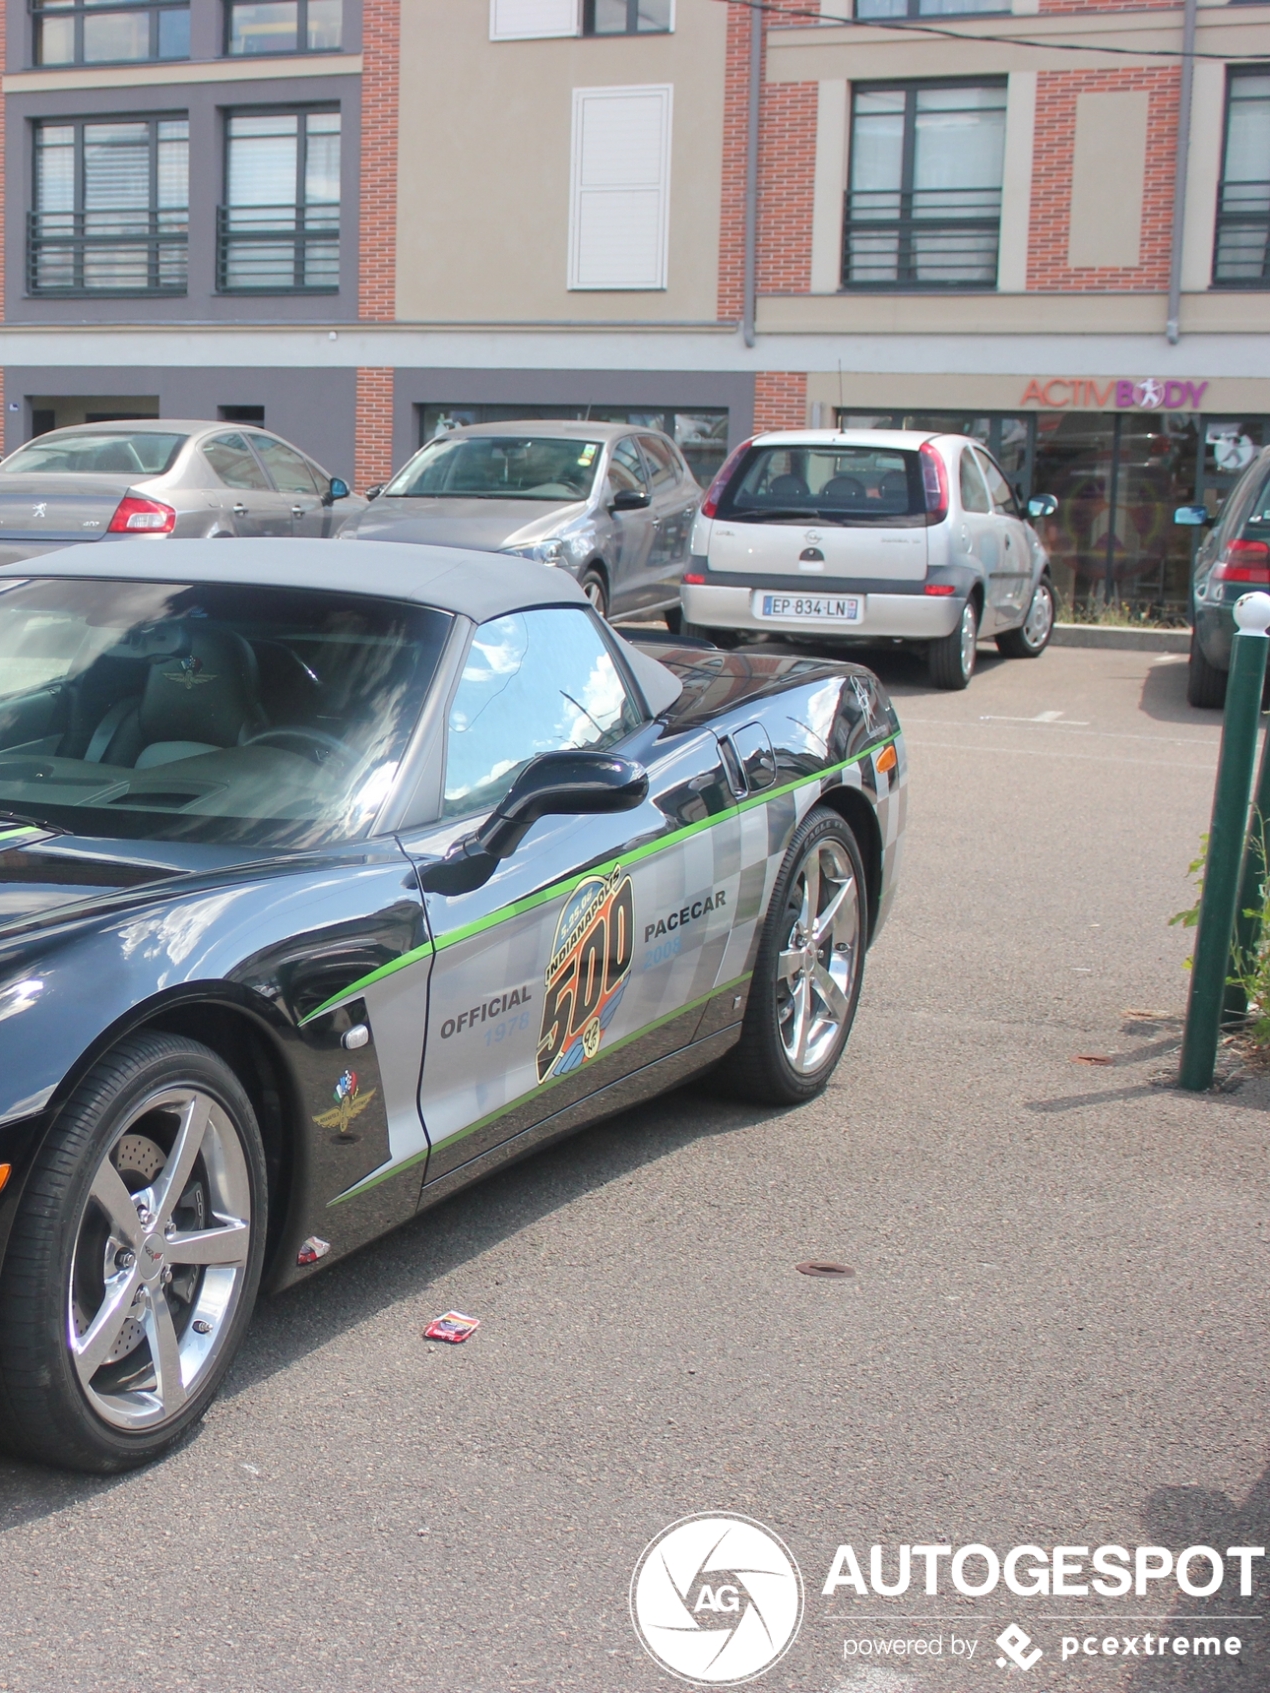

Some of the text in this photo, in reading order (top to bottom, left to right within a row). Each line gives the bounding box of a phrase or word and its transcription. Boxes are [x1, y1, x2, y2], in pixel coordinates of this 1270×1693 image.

[773, 599, 846, 616] EP-834-LN
[545, 870, 620, 981] INDIANAPOLIS
[644, 890, 727, 943] PACECAR
[536, 874, 634, 1085] 500
[642, 936, 682, 970] 2008
[440, 985, 532, 1039] OFFICIAL
[484, 1011, 530, 1047] 1978
